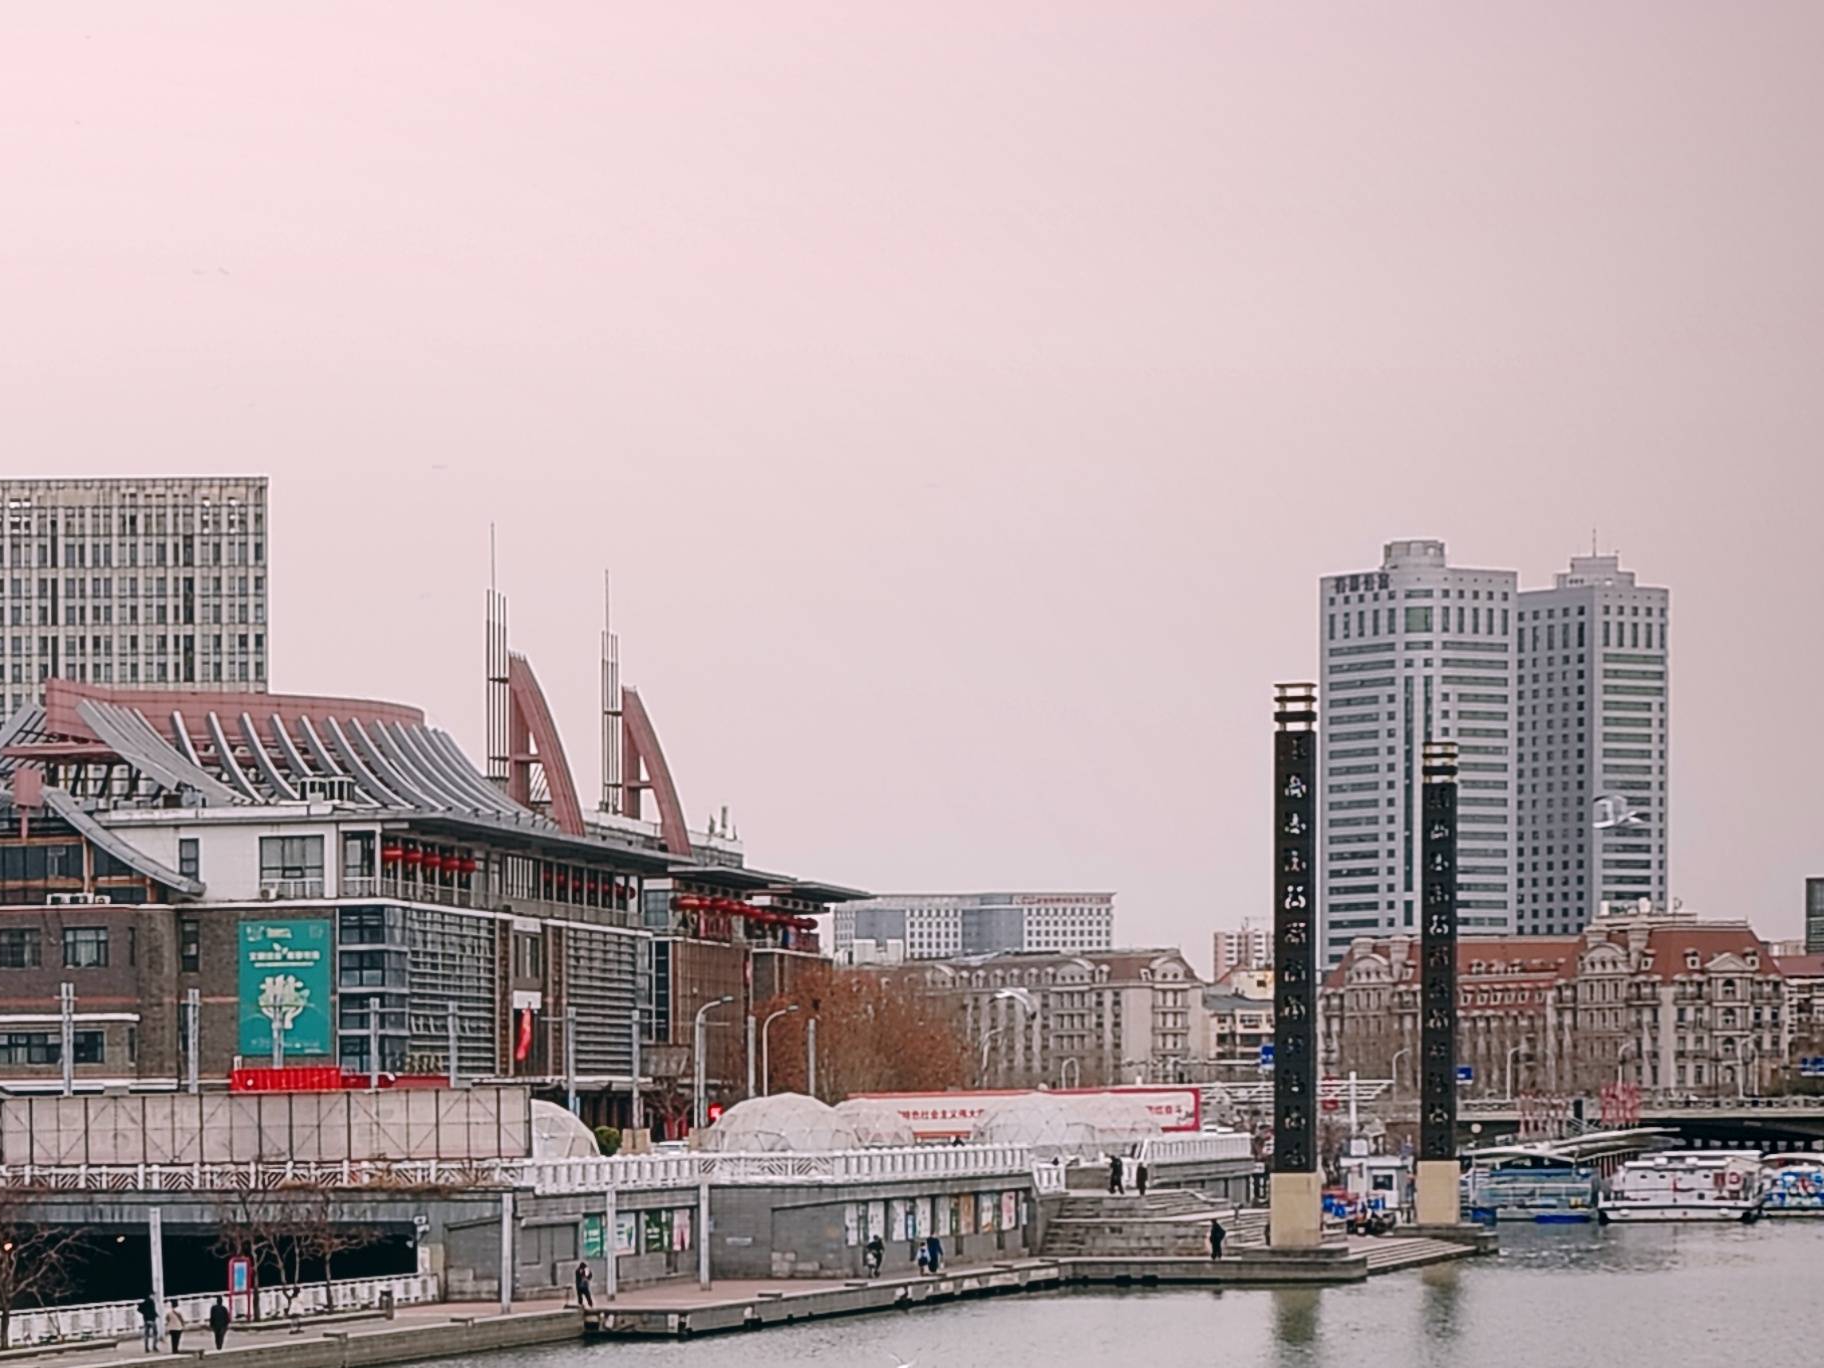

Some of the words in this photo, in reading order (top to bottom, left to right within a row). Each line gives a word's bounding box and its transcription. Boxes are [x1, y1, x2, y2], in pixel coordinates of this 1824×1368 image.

[897, 1109, 984, 1120] 特色社会主义伟大
